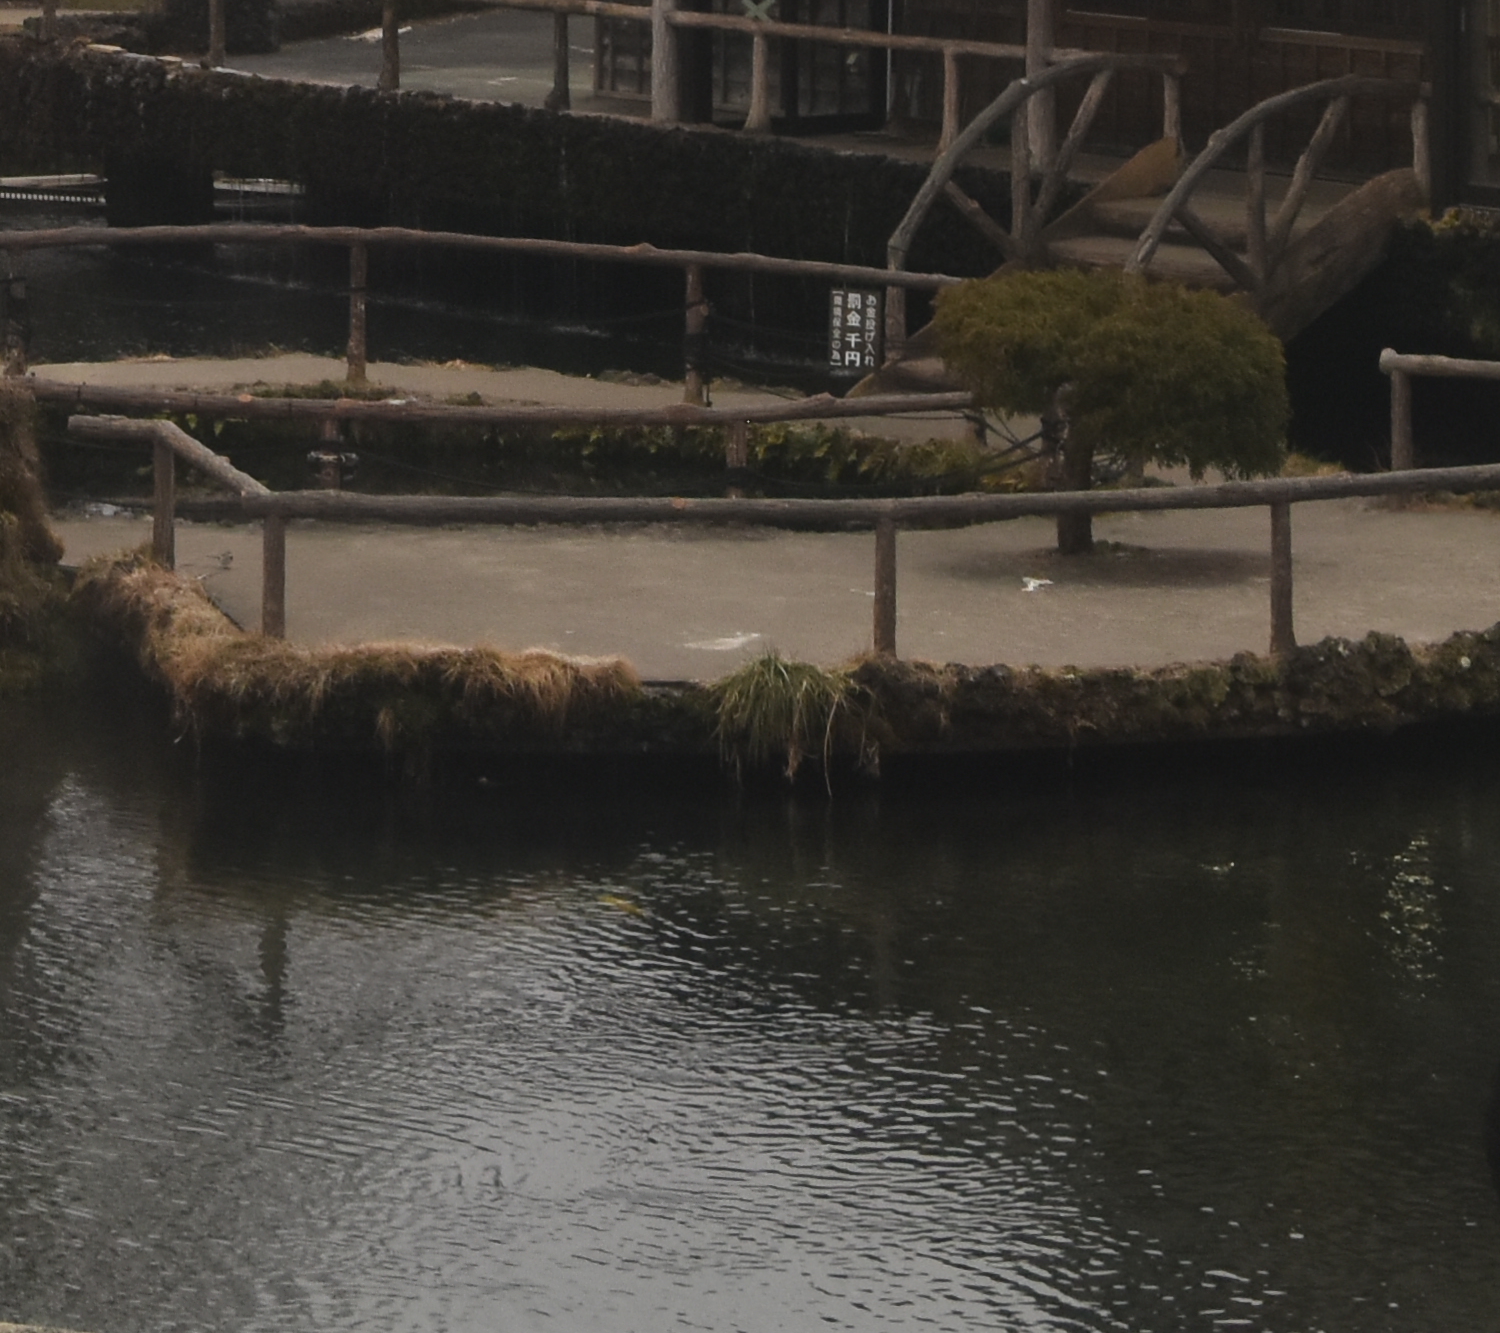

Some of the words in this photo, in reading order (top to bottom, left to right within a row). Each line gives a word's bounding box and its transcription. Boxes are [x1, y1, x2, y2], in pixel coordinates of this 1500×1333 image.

[845, 293, 862, 367] 罰金千円
[864, 294, 877, 367] お金投げ入れ
